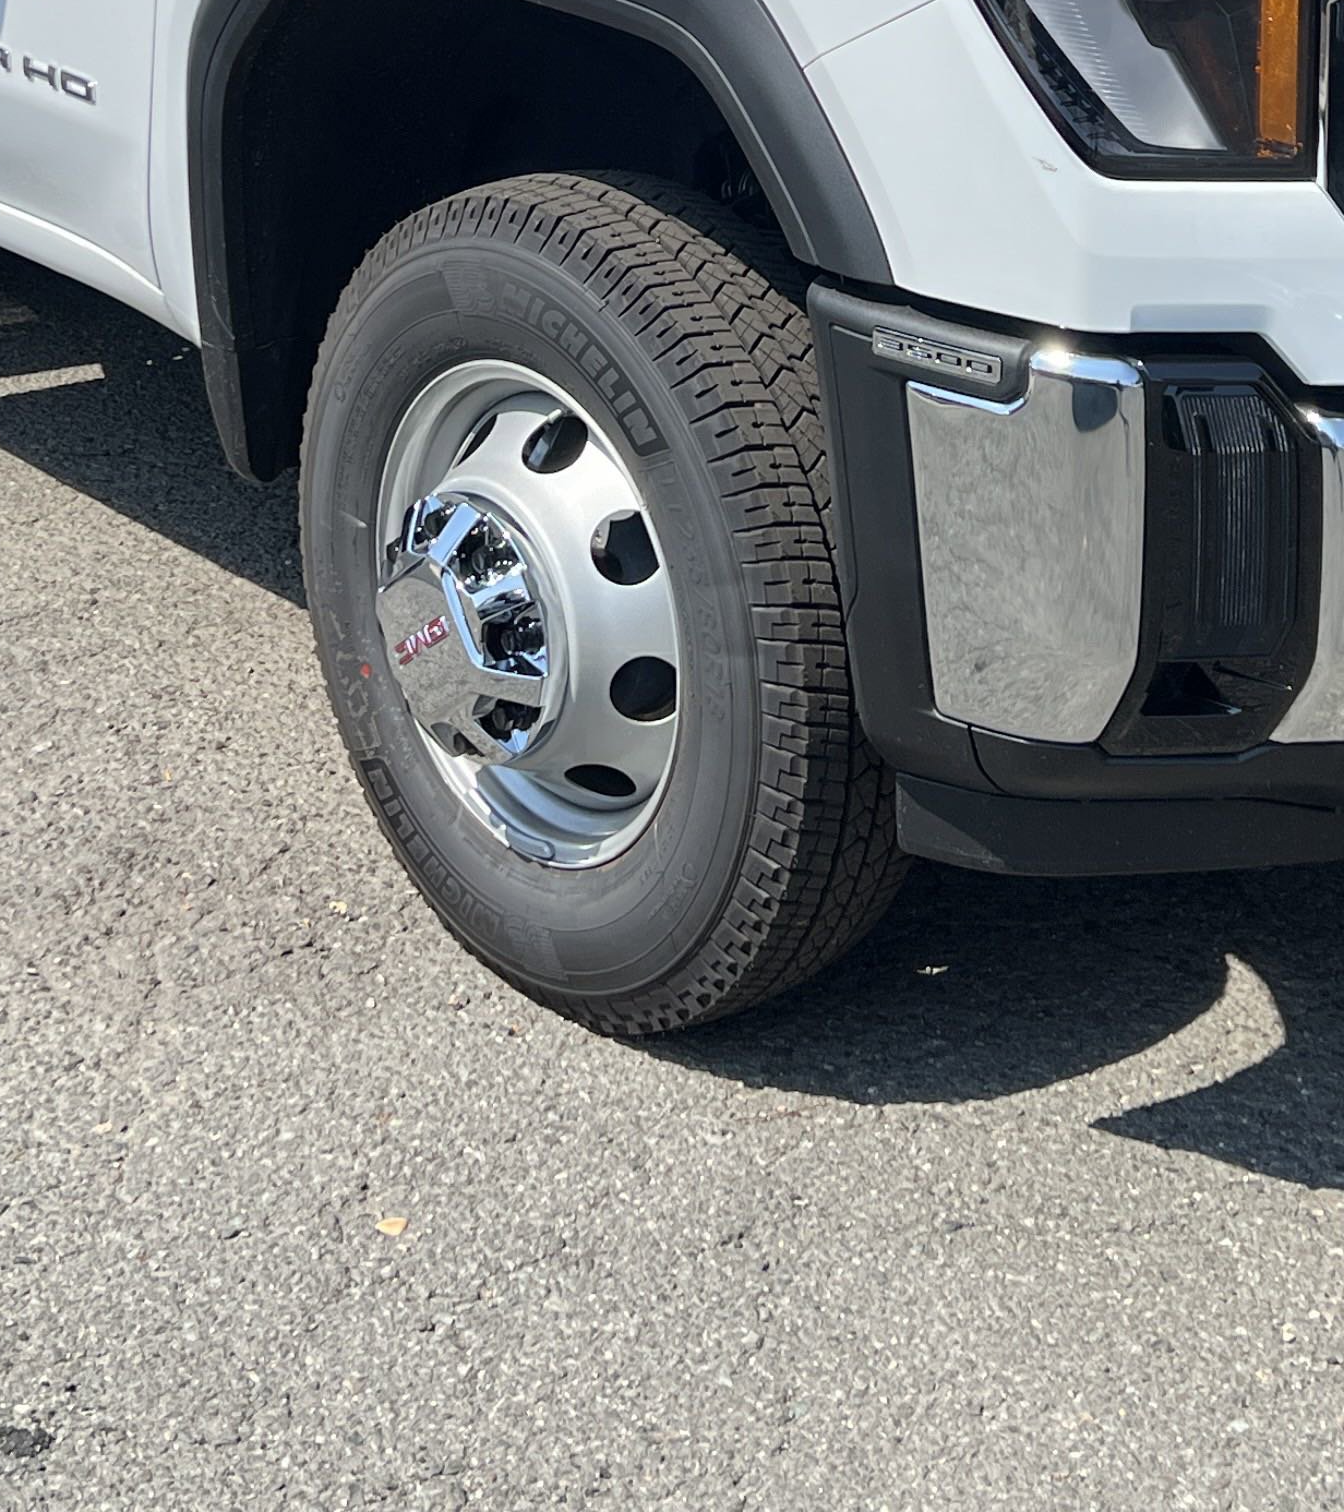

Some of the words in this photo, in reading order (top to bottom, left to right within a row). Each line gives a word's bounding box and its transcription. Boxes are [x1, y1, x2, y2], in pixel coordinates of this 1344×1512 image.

[22, 53, 97, 105] HD
[501, 282, 657, 451] MICHELIN
[877, 337, 993, 374] 3500
[394, 615, 450, 668] GMC
[367, 768, 500, 935] MICHELIN
